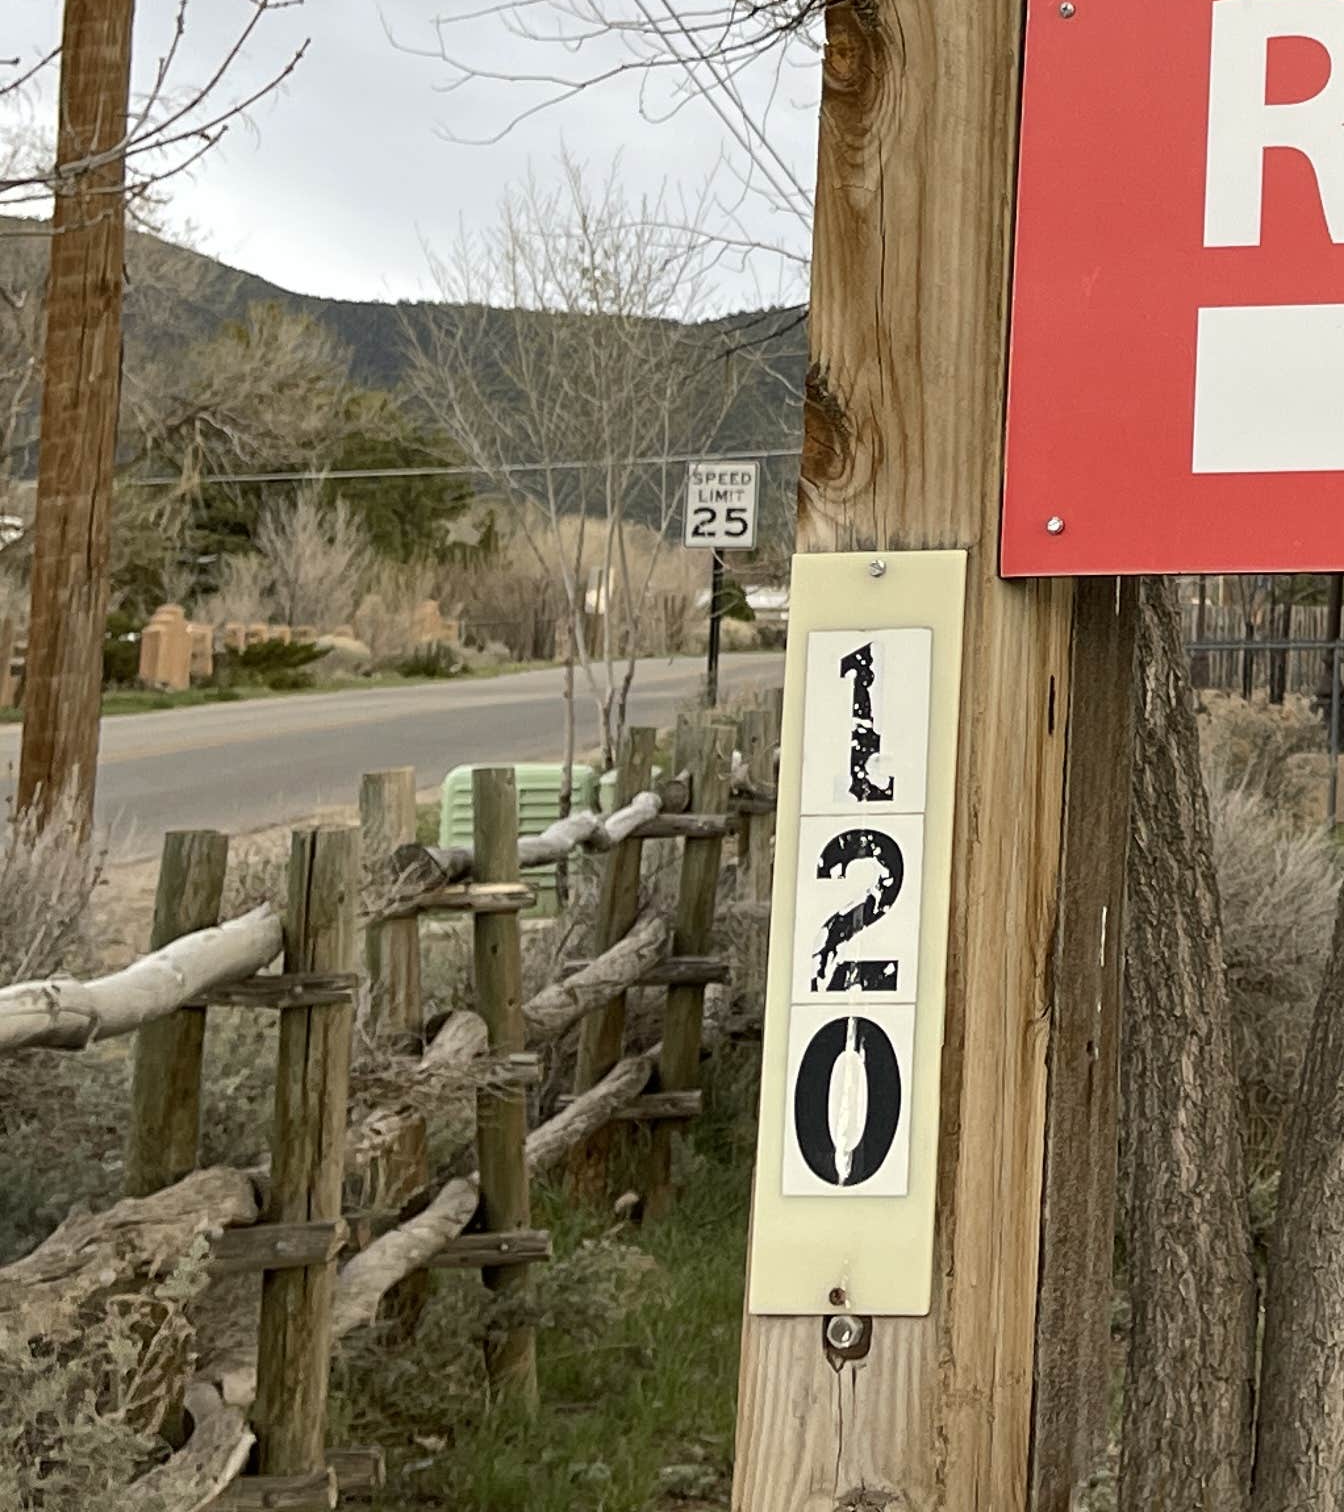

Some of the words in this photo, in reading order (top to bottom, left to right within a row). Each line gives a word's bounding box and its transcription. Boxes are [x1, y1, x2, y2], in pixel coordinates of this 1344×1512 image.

[692, 471, 752, 486] SPEED
[698, 488, 745, 503] LIMIT
[691, 507, 748, 538] 25
[794, 641, 905, 1187] 120
